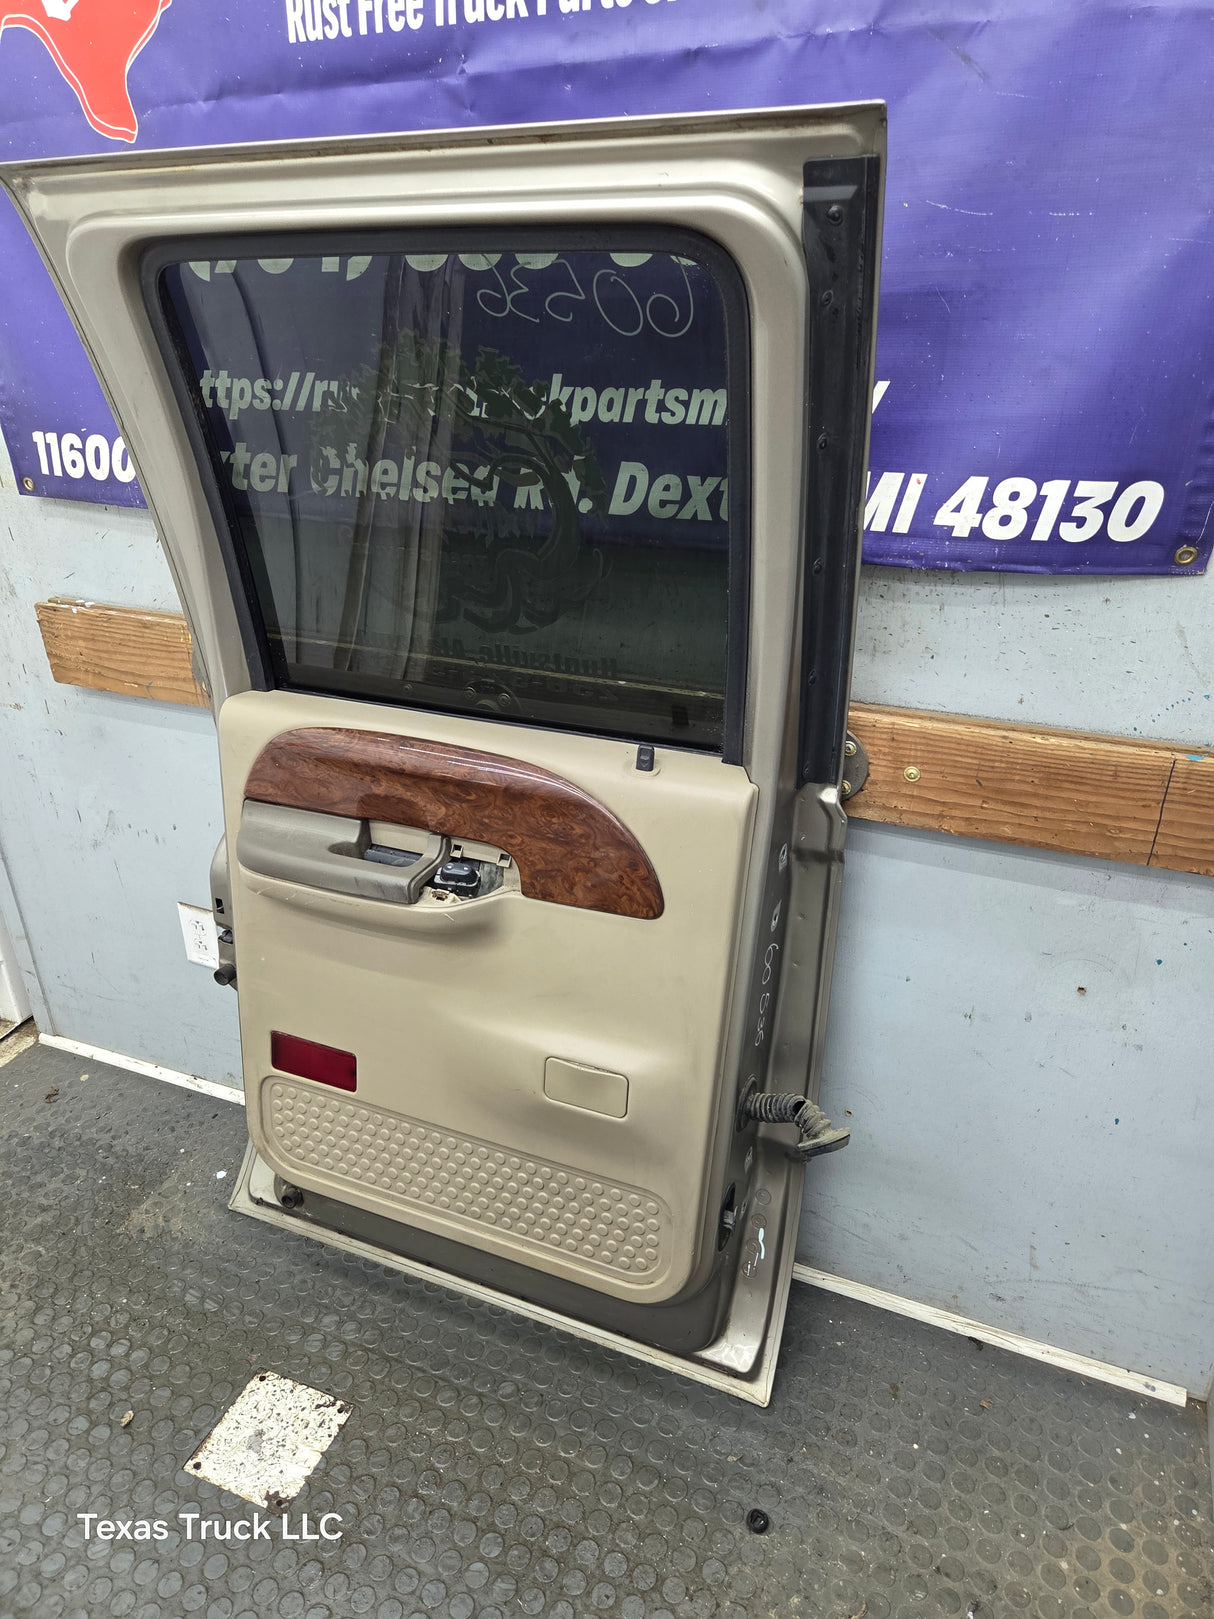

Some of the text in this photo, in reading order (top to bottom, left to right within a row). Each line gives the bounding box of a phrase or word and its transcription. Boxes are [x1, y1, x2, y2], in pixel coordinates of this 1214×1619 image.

[285, 0, 352, 43] Rust
[357, 0, 424, 35] Free
[32, 430, 137, 483] 11600
[216, 442, 298, 493] ter
[933, 475, 1165, 543] 48130
